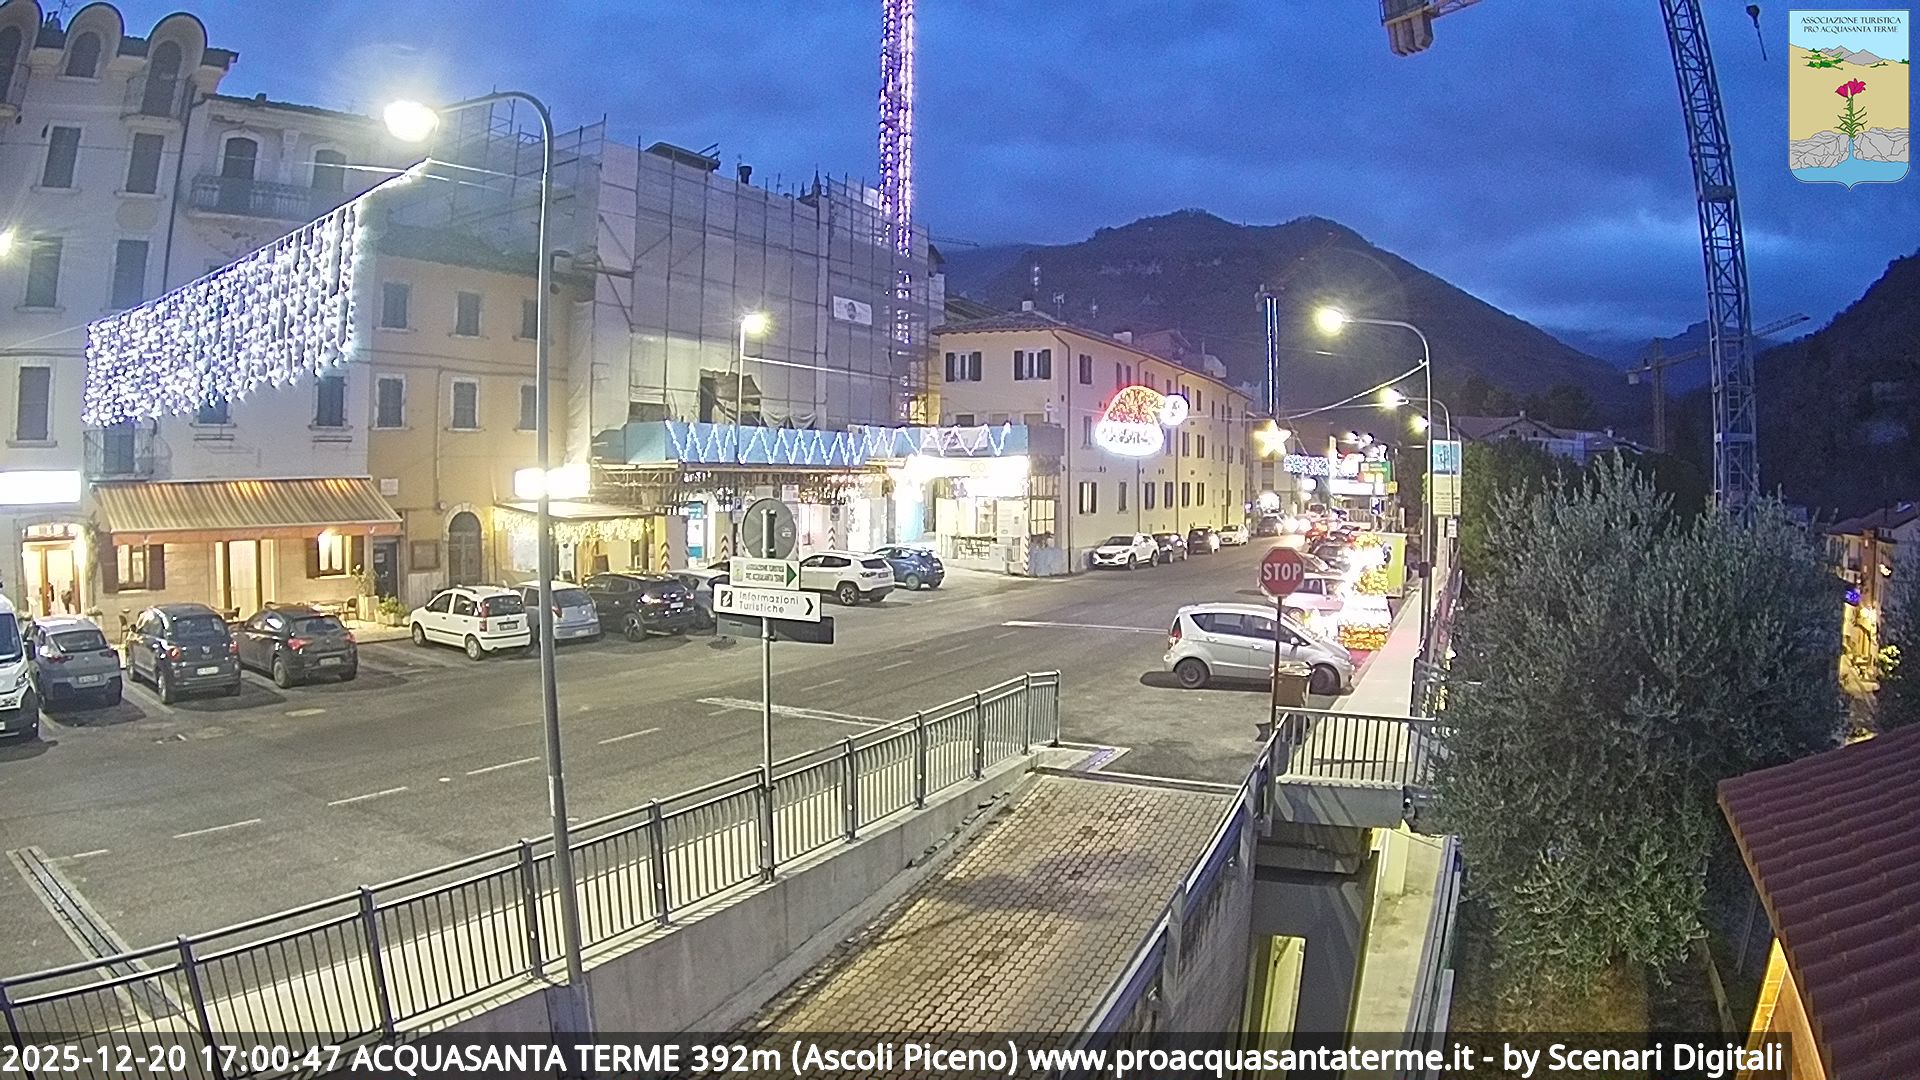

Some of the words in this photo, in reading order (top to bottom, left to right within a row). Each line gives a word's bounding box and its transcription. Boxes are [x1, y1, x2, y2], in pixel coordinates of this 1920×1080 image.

[1263, 562, 1302, 581] STOP
[739, 591, 799, 605] Informazioni
[739, 601, 785, 614] Turistiche
